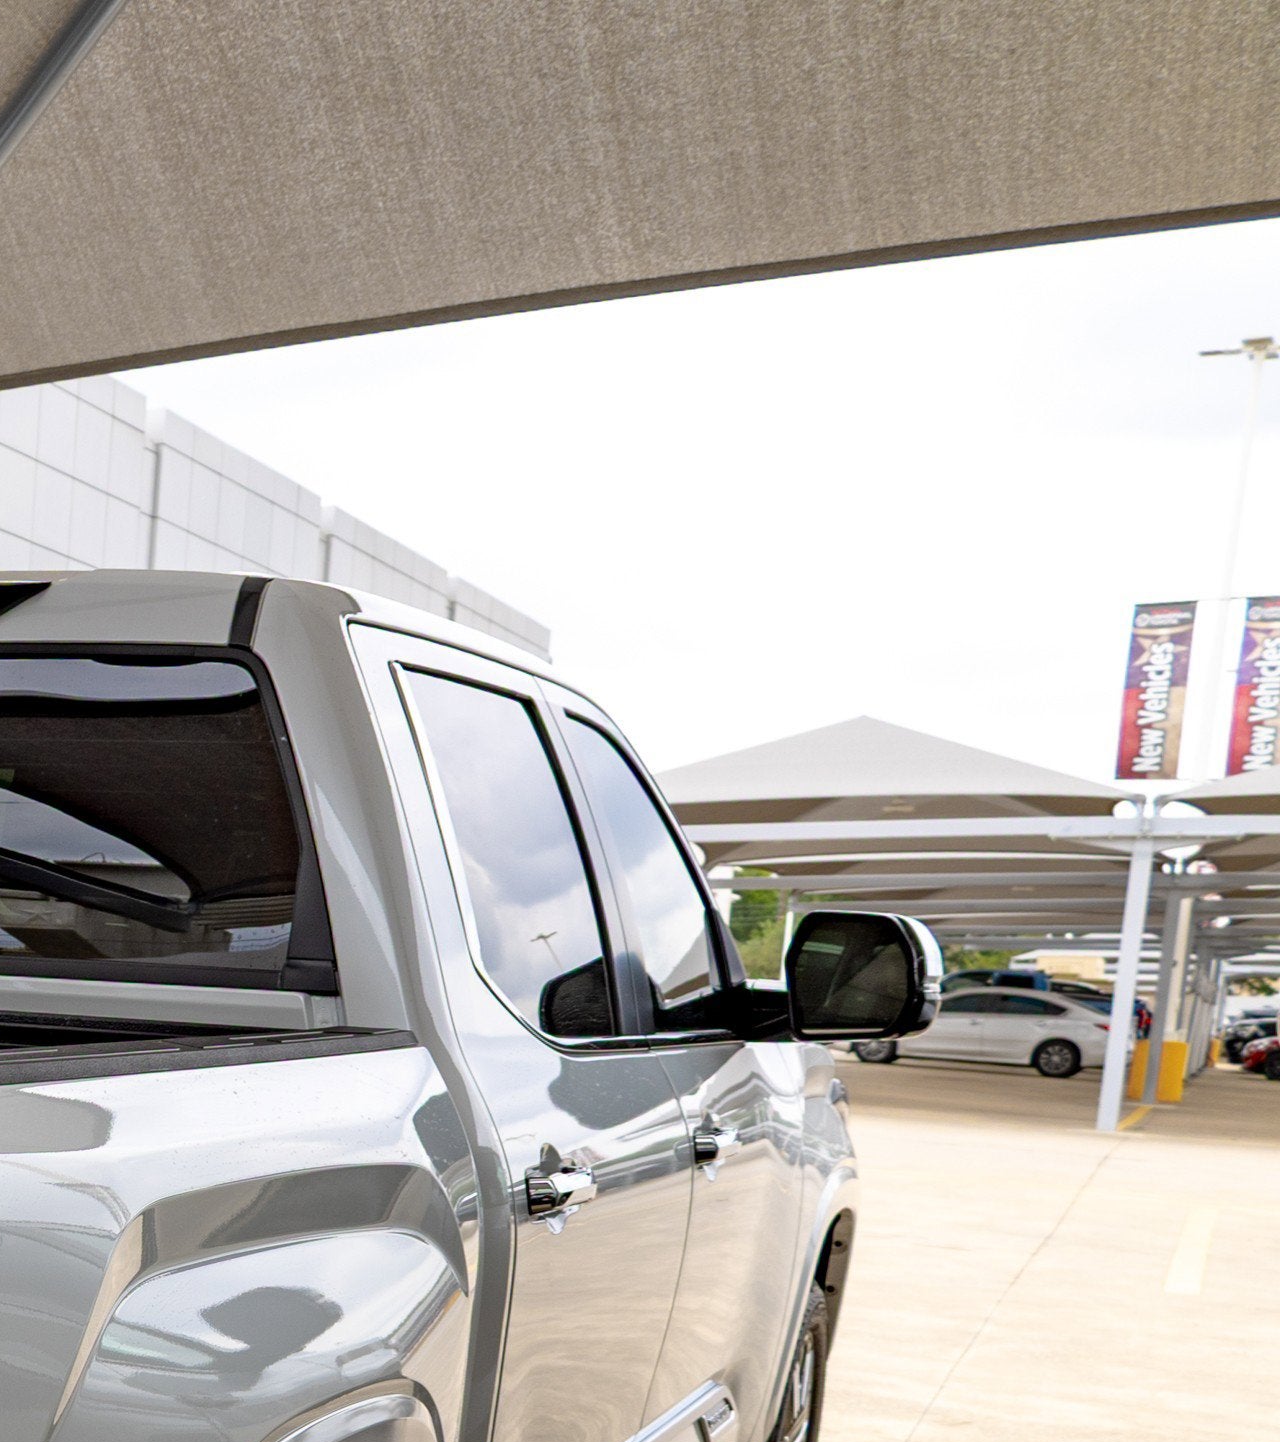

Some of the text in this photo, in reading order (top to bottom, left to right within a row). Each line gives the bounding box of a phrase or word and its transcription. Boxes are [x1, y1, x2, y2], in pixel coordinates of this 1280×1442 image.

[1136, 641, 1175, 725] Vehicles
[1131, 728, 1165, 773] New
[1242, 726, 1276, 771] New
